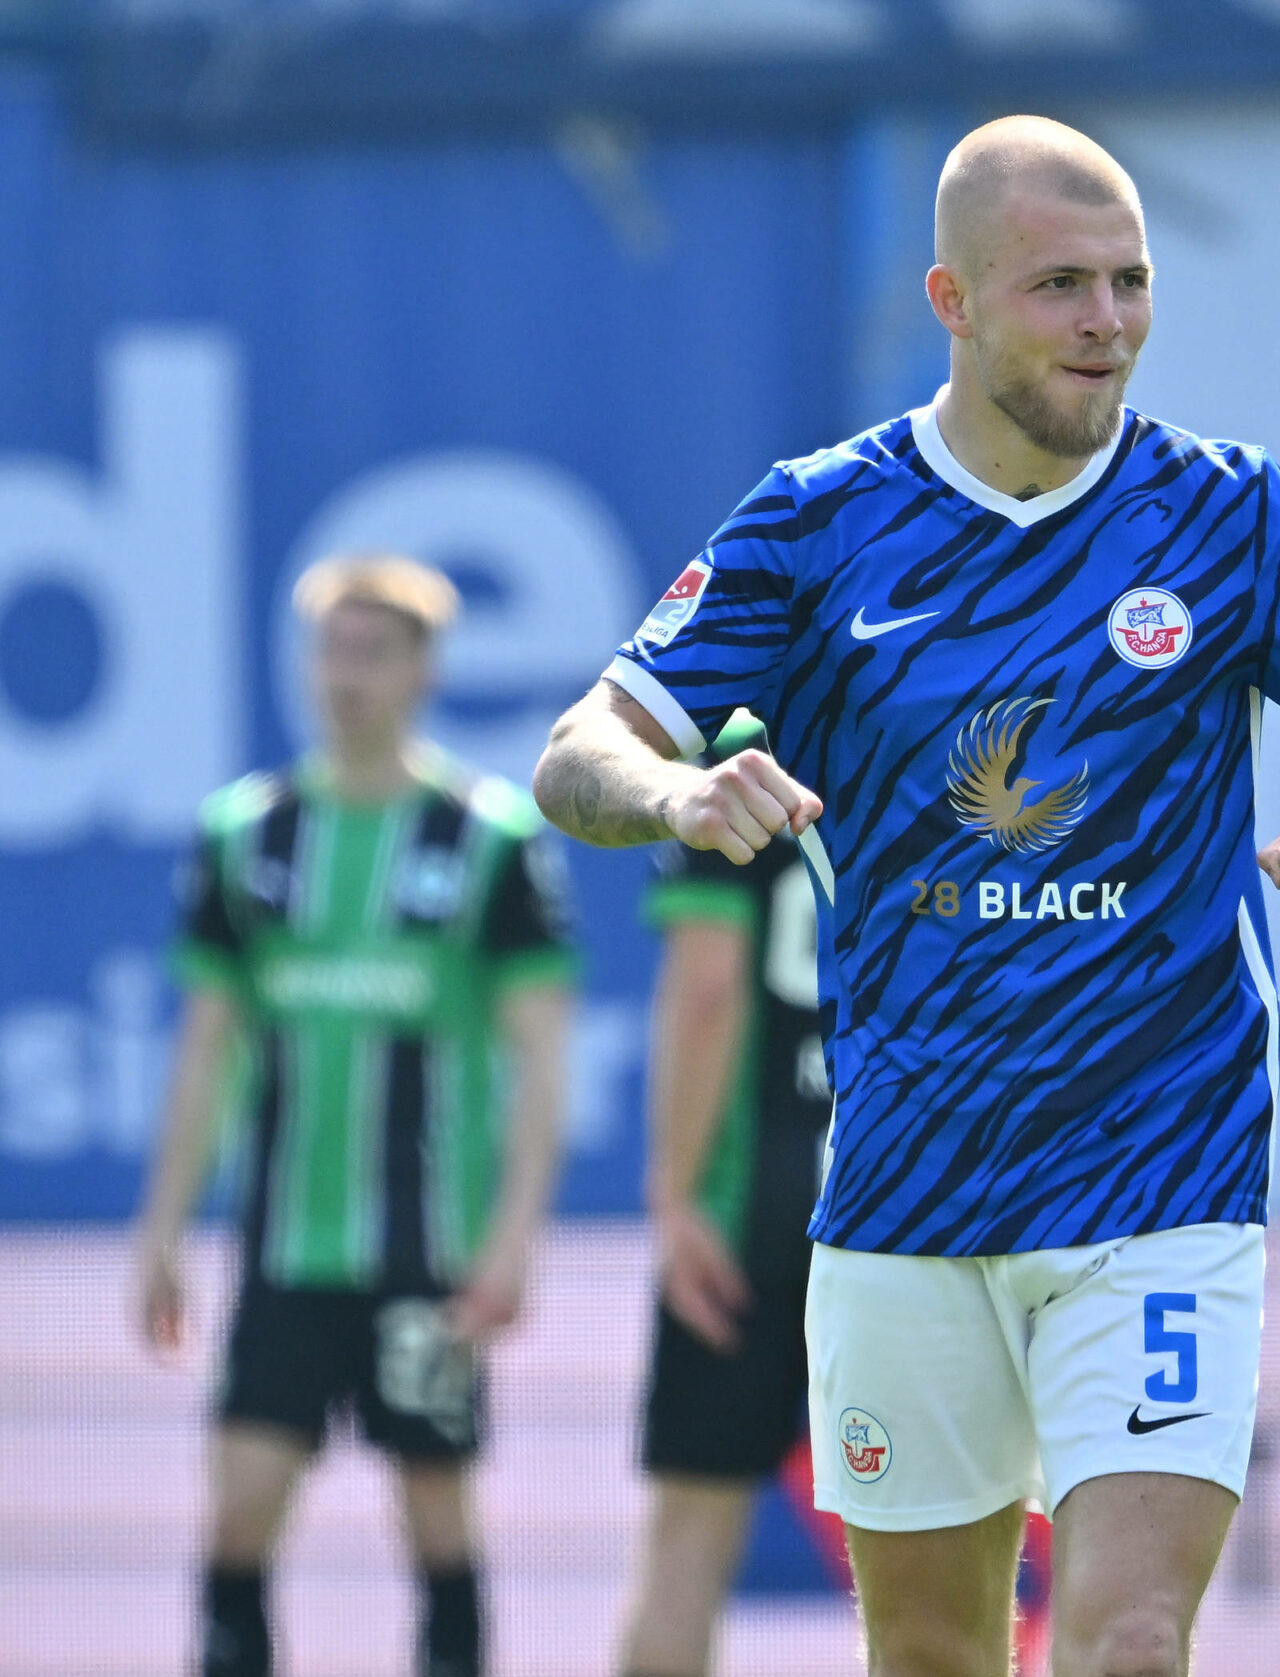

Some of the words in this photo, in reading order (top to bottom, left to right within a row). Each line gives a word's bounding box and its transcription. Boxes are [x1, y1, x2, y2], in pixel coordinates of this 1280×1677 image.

[1140, 632, 1167, 653] HANSA
[911, 879, 961, 917] 28
[979, 881, 1127, 920] BLACK
[1144, 1292, 1198, 1403] 5
